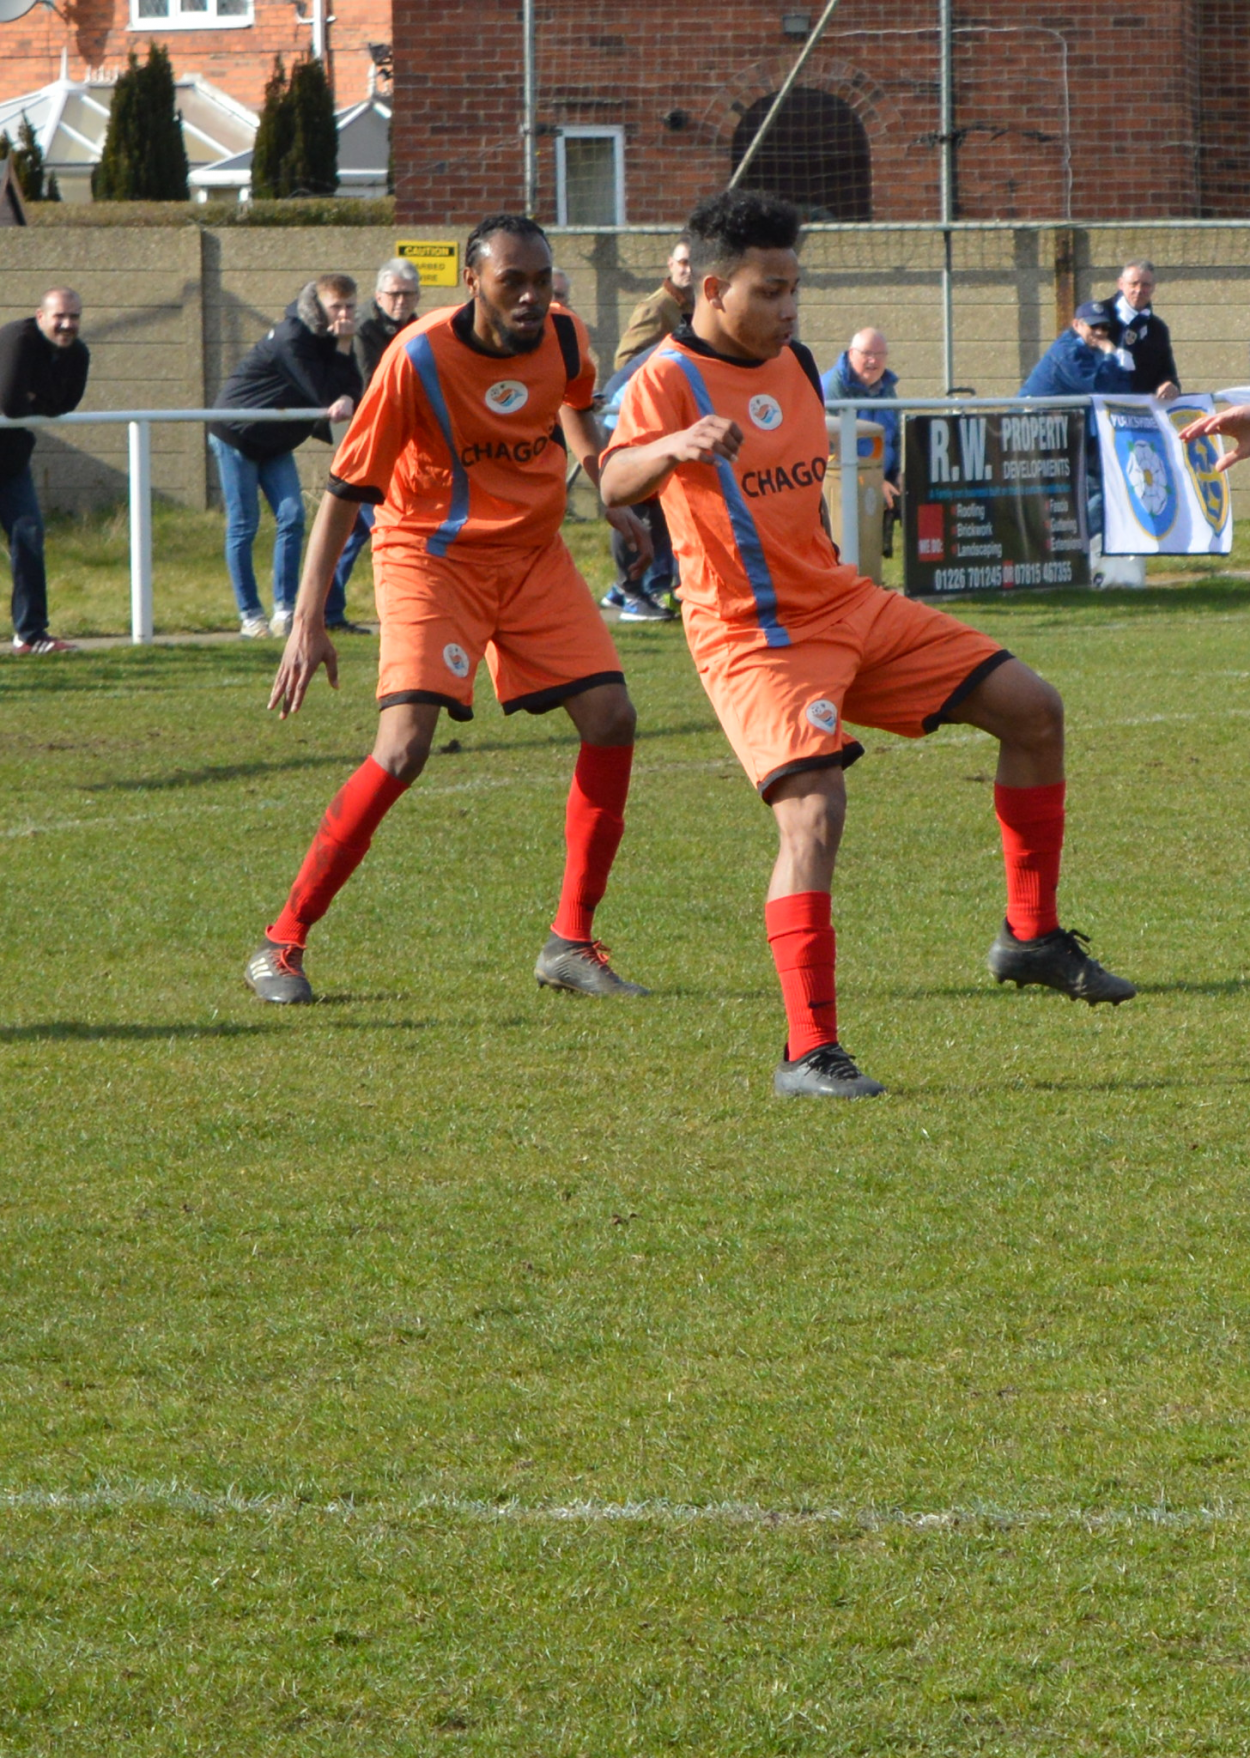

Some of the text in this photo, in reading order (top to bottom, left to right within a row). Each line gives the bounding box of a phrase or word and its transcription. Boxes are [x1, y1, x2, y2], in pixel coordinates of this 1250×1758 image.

[404, 247, 450, 256] CAUTION
[415, 263, 445, 271] ARBED
[1002, 416, 1069, 451] PROPERTY
[930, 417, 993, 483] R.W.
[741, 456, 827, 498] CHAGO
[1003, 458, 1070, 479] DEVELOPMENTS
[957, 503, 985, 520] Roofing
[957, 523, 993, 537] Brickwork
[957, 541, 1003, 558] Landscaping
[935, 568, 965, 590] 01226
[968, 565, 1002, 588] 701245
